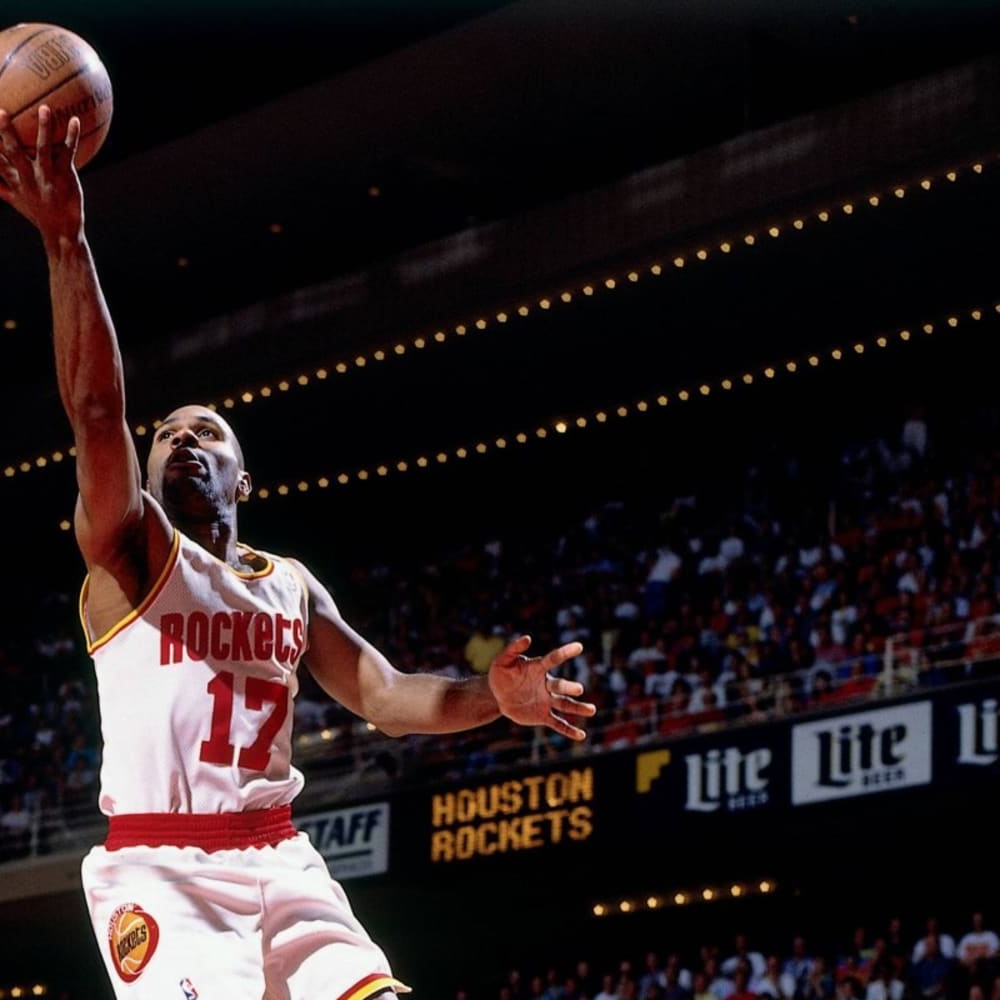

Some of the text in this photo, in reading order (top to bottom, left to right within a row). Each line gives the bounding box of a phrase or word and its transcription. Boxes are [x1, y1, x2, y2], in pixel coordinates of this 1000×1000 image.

[199, 669, 289, 771] 17
[685, 747, 772, 812] Lite
[818, 723, 907, 788] Lite
[432, 767, 594, 827] HOUSTON
[301, 809, 382, 851] TAFF
[431, 805, 594, 862] ROCKETS
